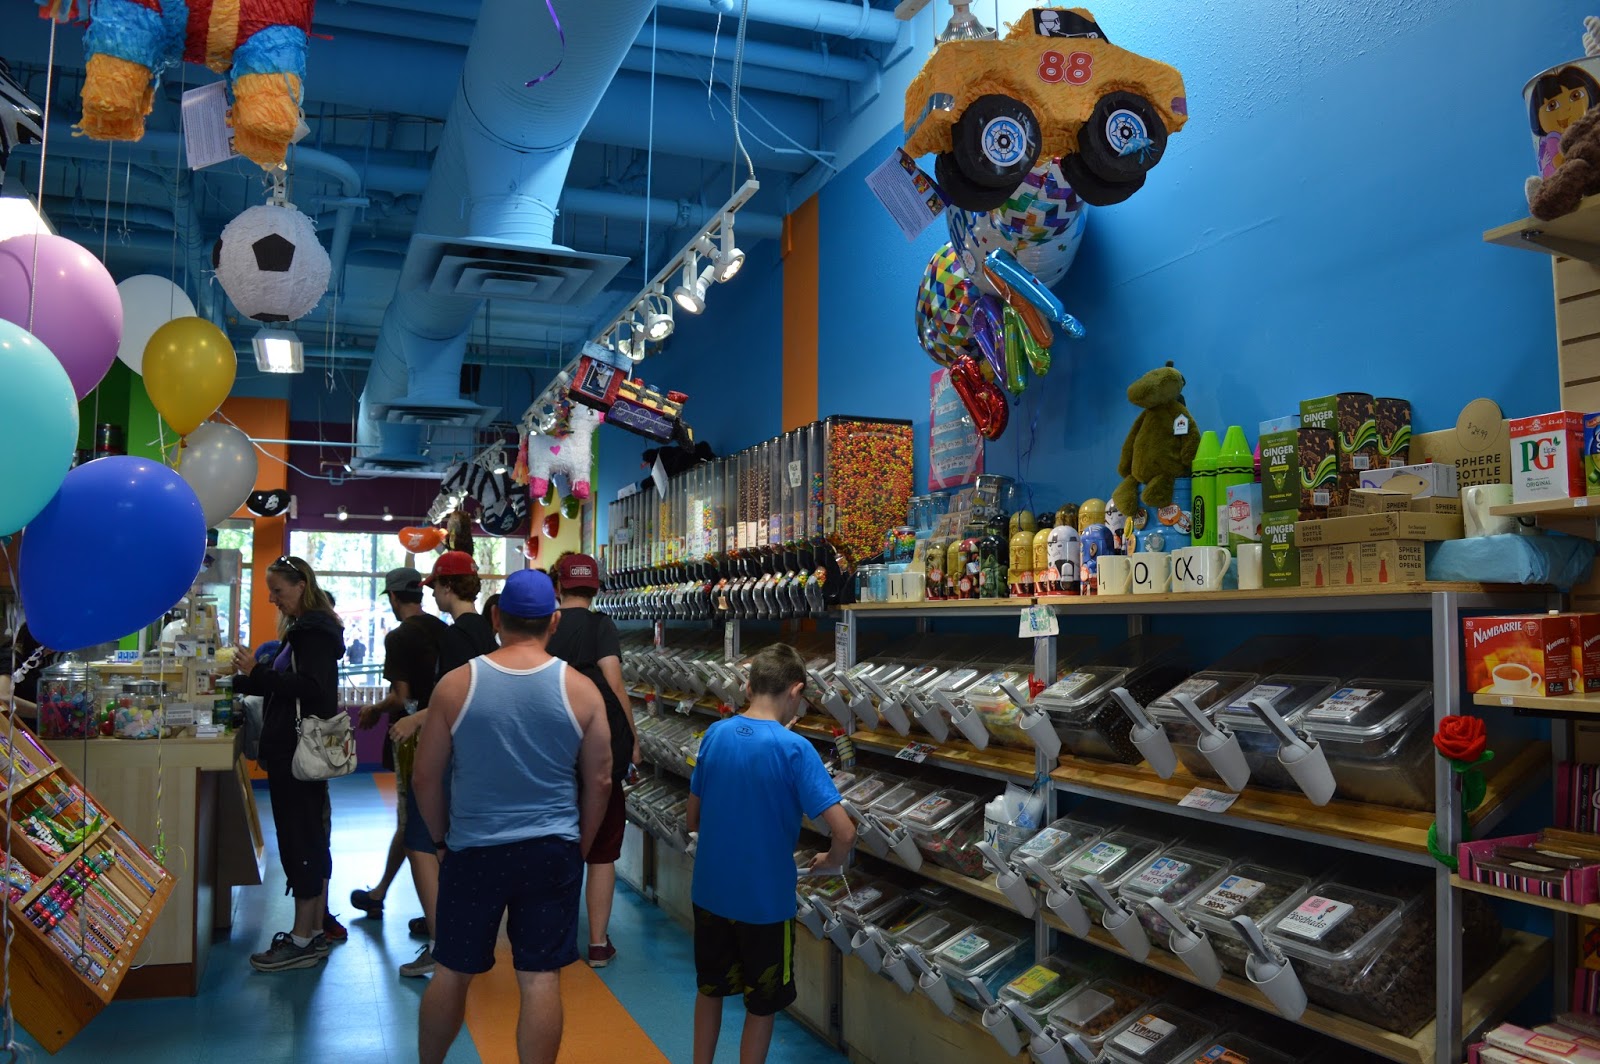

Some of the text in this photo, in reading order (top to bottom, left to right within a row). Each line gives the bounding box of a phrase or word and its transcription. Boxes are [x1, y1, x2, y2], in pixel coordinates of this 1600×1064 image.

[1038, 50, 1094, 86] 88
[1303, 410, 1334, 423] GINGER
[1263, 445, 1294, 457] GINGER
[1520, 438, 1556, 473] PG
[1543, 446, 1557, 455] tips
[1271, 455, 1286, 466] ALE
[1455, 453, 1501, 468] SPHERE
[1456, 467, 1501, 480] BOTTLE
[1526, 480, 1552, 488] ORIGINAL
[1194, 497, 1204, 537] Crayola
[1265, 524, 1294, 535] GINGER
[1272, 534, 1287, 543] ALE
[1399, 546, 1421, 554] SPHERE
[1473, 621, 1522, 649] NAMBARRIE
[89, 923, 116, 951] mentos
